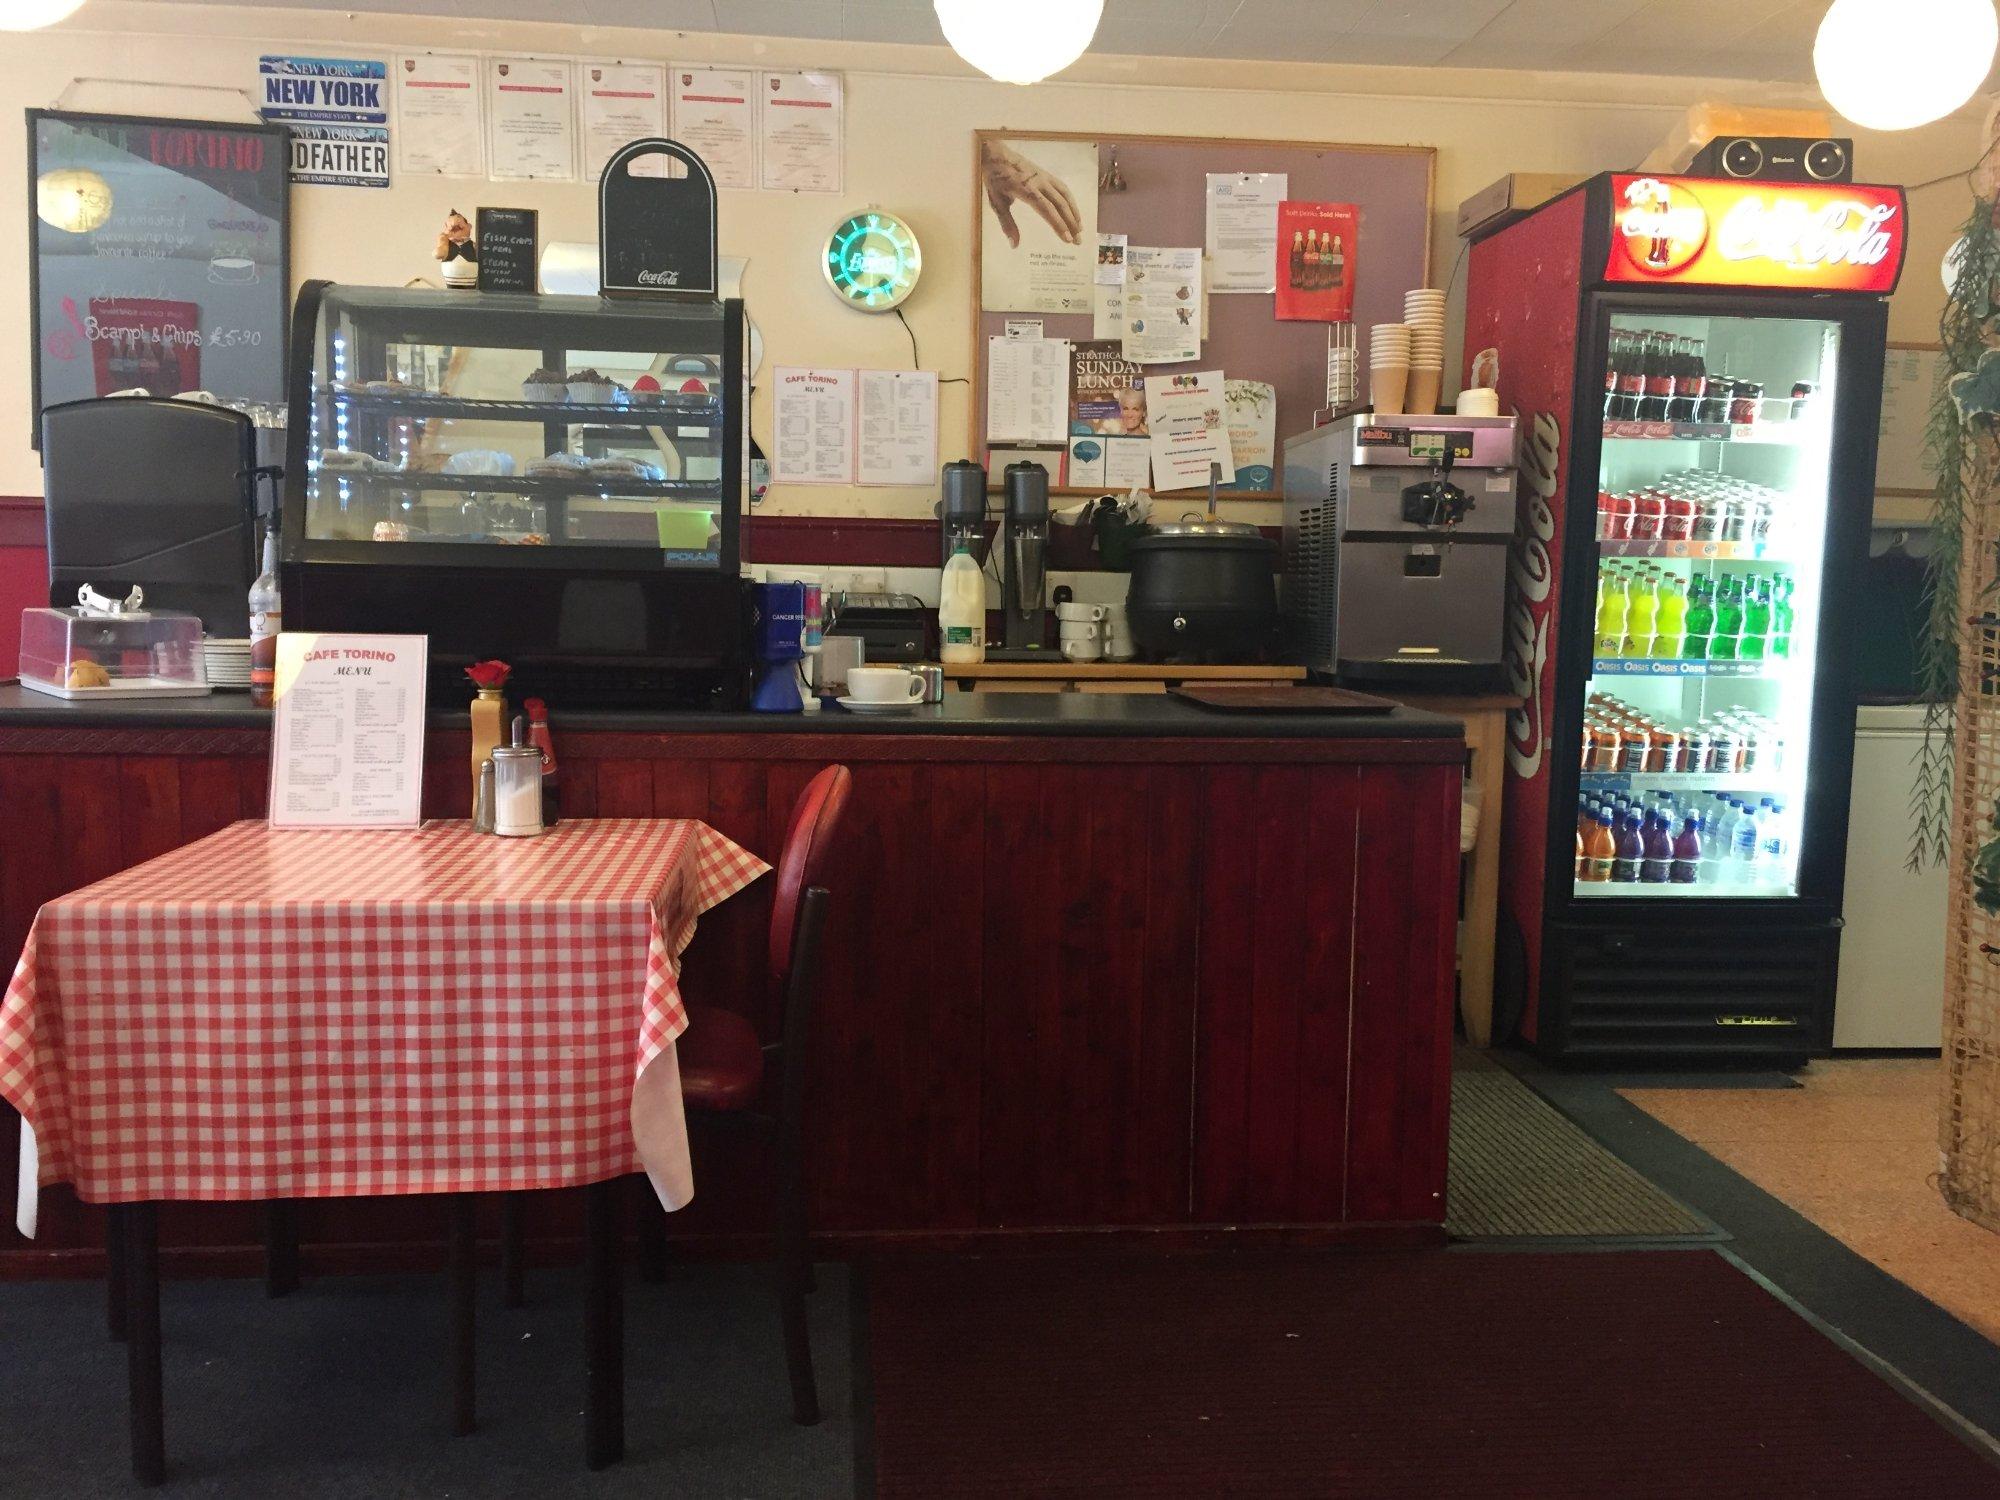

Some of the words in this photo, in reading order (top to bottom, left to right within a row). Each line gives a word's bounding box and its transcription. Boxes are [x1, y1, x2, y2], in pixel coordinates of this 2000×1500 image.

[293, 63, 320, 76] NEW
[322, 64, 353, 77] YORK
[266, 78, 315, 105] NEW
[320, 81, 379, 108] YORK
[296, 126, 321, 139] NEW
[323, 127, 357, 141] YORK
[311, 175, 335, 183] EMPIRE
[638, 270, 679, 285] Coca-Cola
[84, 315, 145, 350] Scampi
[151, 327, 161, 344] &
[162, 323, 203, 351] Chips
[1075, 351, 1122, 360] STRATHCA
[1076, 361, 1144, 375] SUNDAY
[785, 376, 806, 384] CAFE
[808, 375, 838, 386] TORINO
[1076, 375, 1134, 389] LUNCH
[303, 649, 340, 662] CAFE
[343, 649, 396, 663] TORINO
[333, 666, 373, 676] MENU
